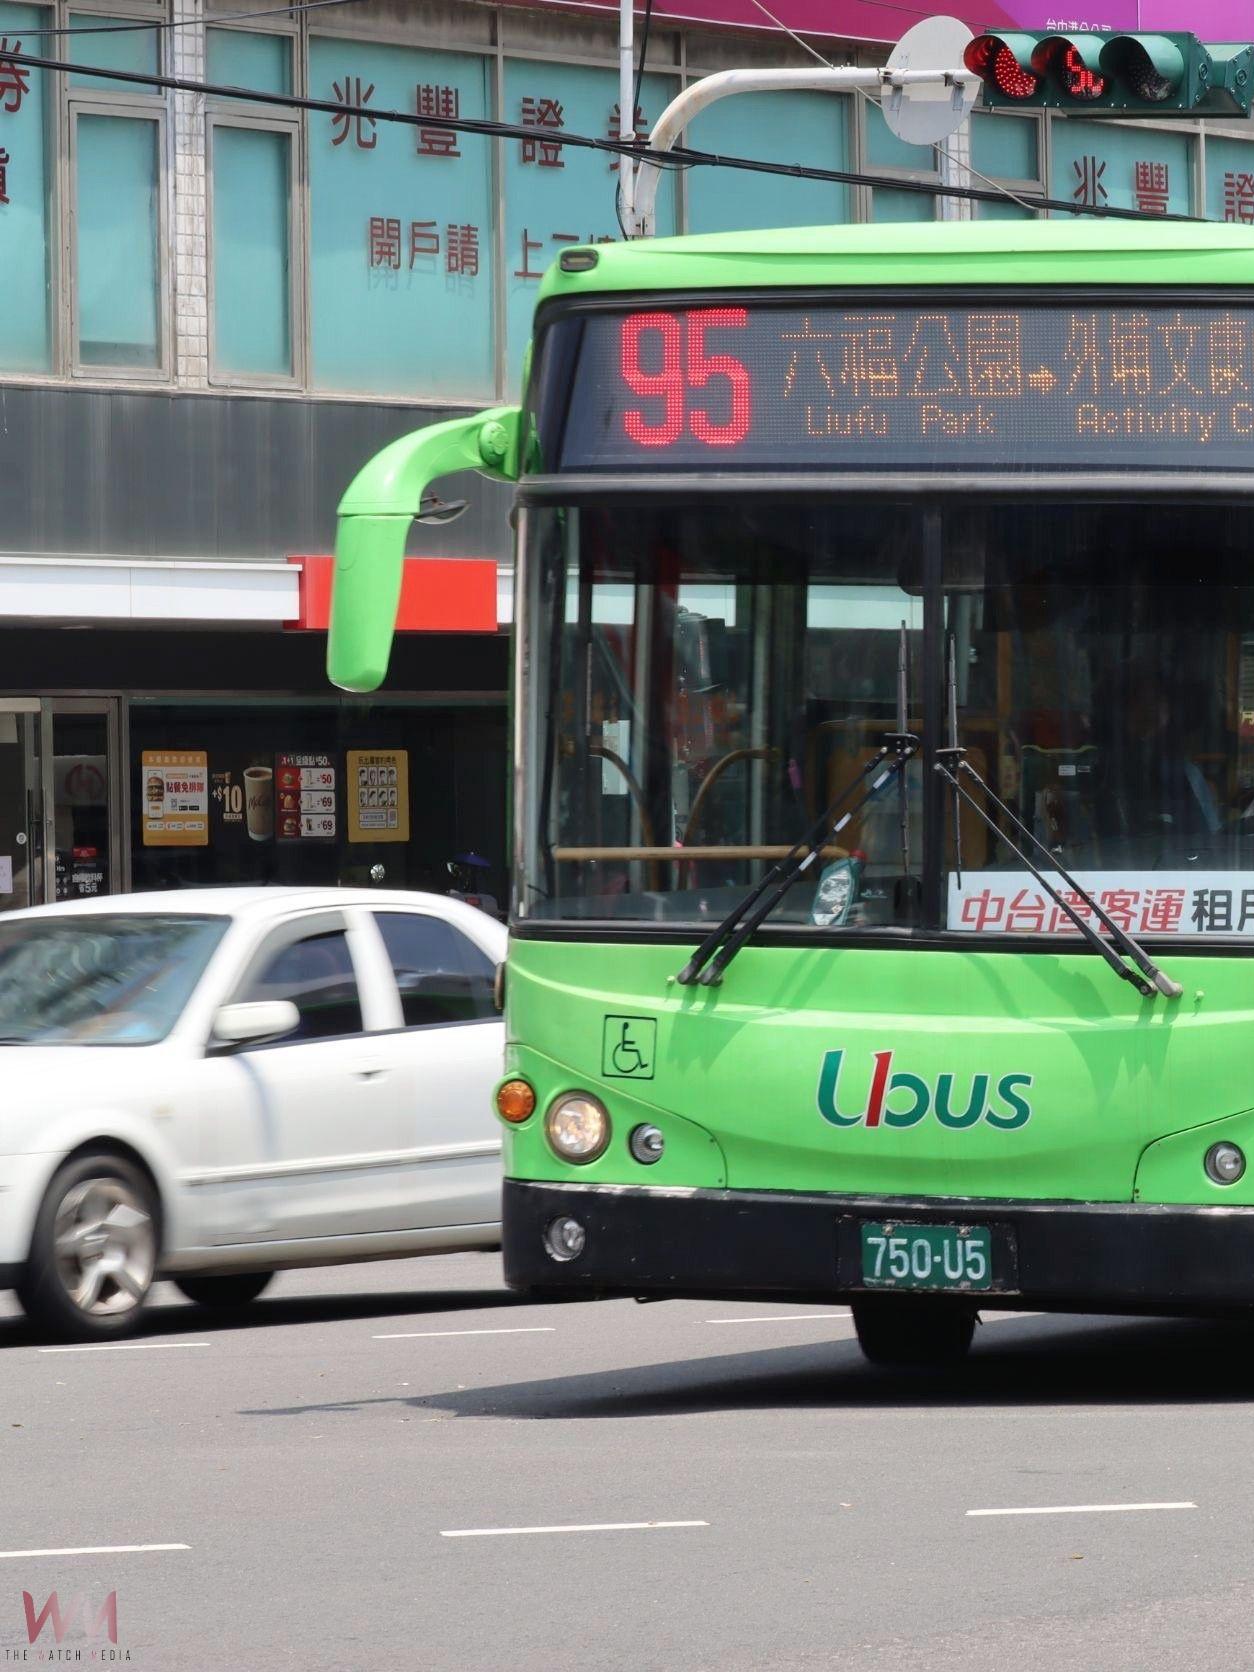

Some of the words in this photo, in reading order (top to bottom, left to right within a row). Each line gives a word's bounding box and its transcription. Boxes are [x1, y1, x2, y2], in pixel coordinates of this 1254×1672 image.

[370, 217, 479, 276] 開戶請
[620, 308, 751, 446] 95
[806, 404, 889, 435] Liufu
[921, 404, 996, 435] Park
[1076, 403, 1216, 442] Activity
[816, 1048, 1033, 1130] Ubus
[867, 1237, 987, 1280] 750-U5
